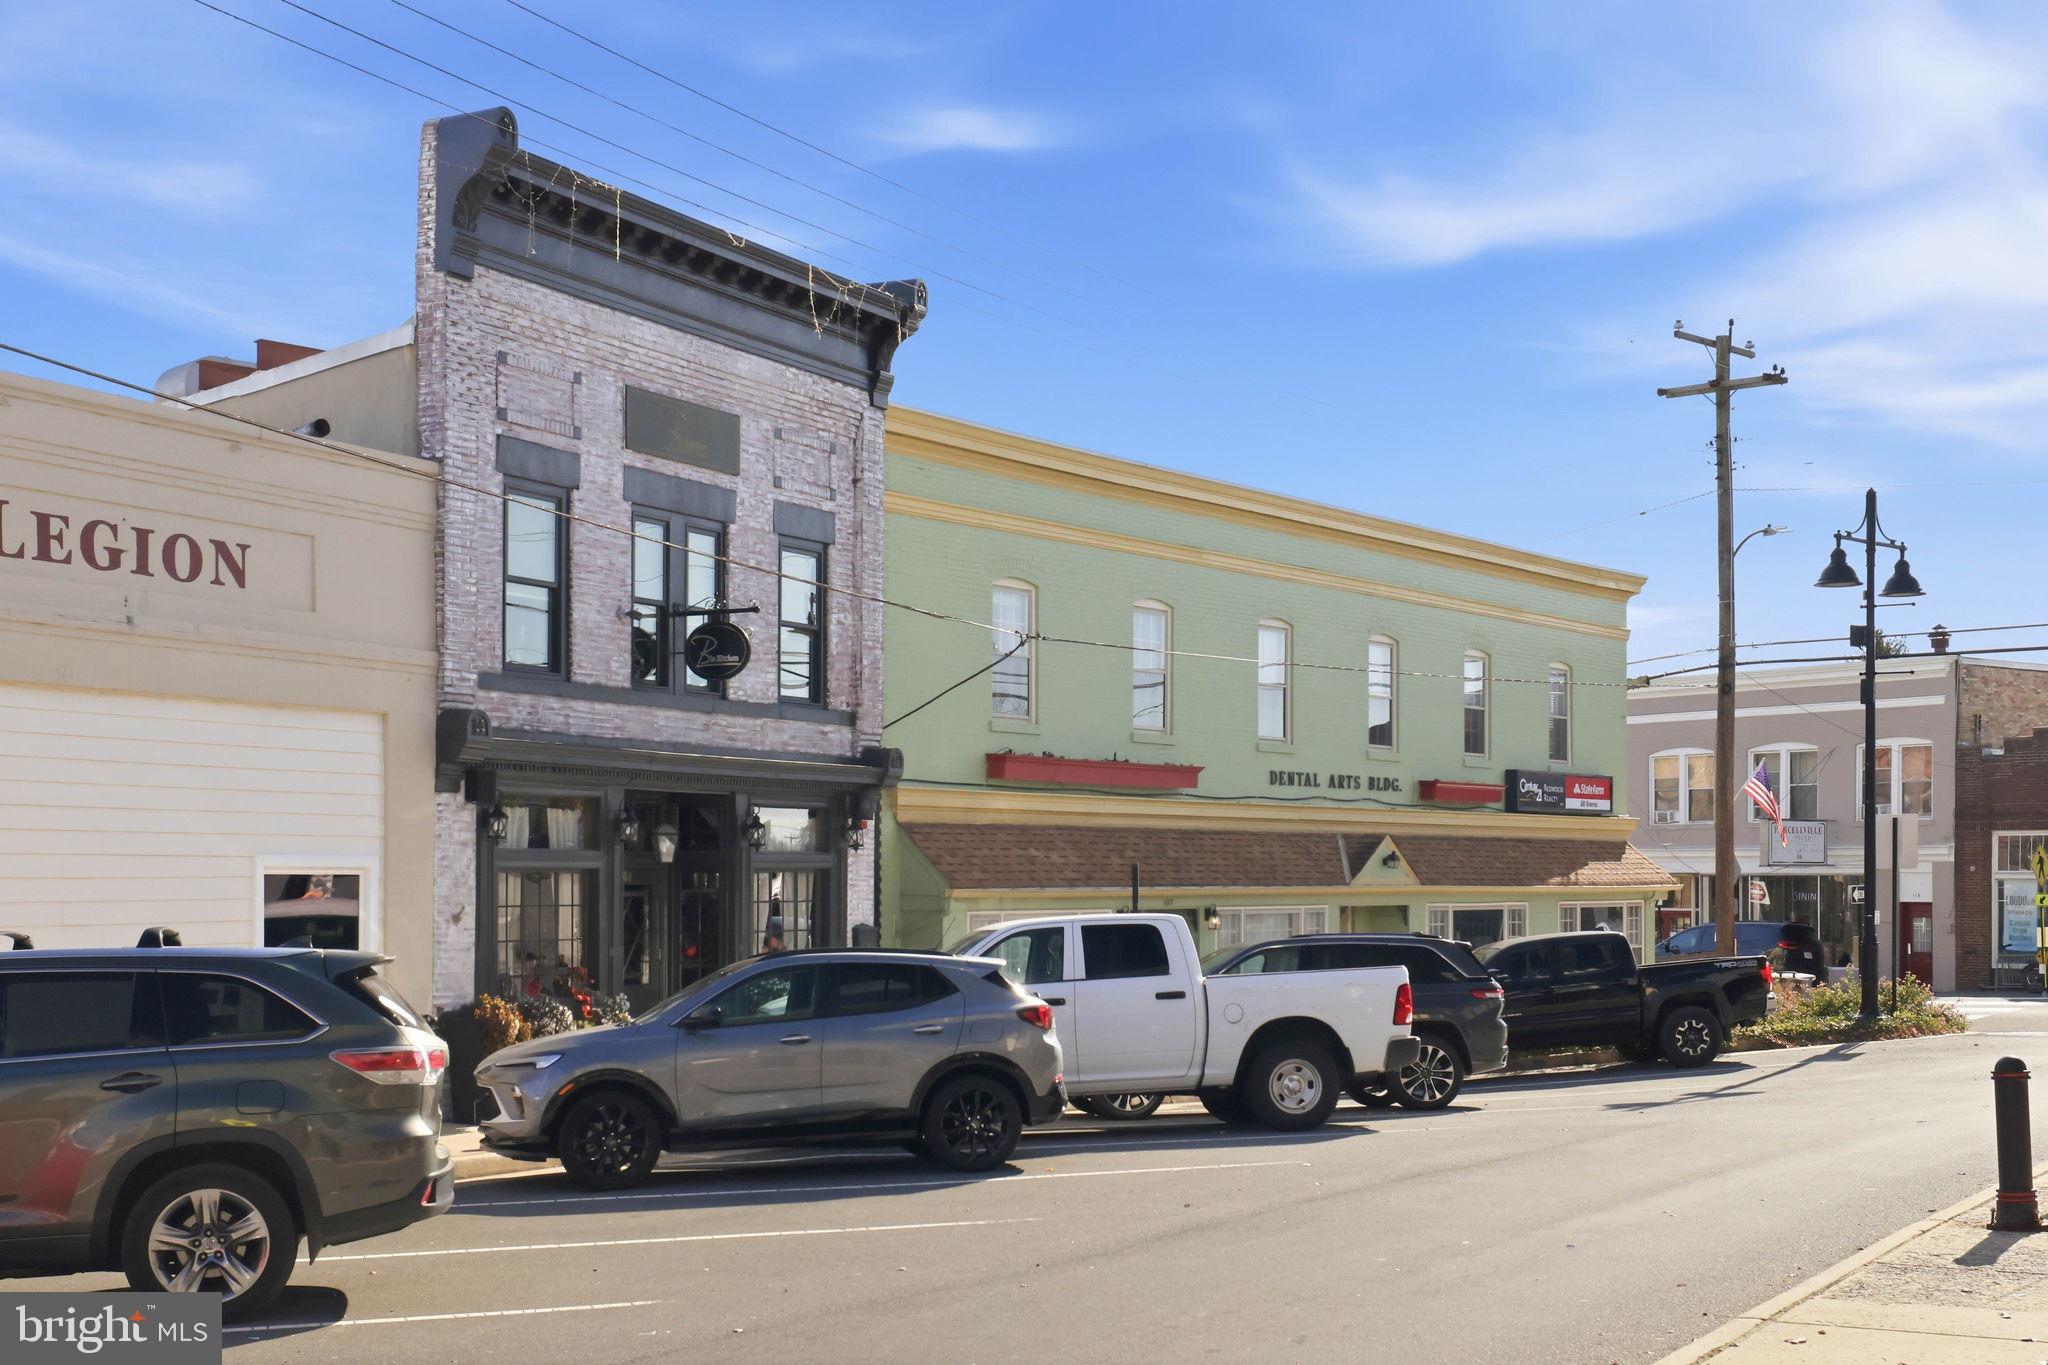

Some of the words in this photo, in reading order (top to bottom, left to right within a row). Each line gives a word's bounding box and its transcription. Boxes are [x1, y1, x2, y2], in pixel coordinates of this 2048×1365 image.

[0, 500, 251, 589] LEGION
[1269, 770, 1320, 787] DENTAL
[1328, 774, 1360, 789] ARTS
[1368, 776, 1402, 792] BLDG.
